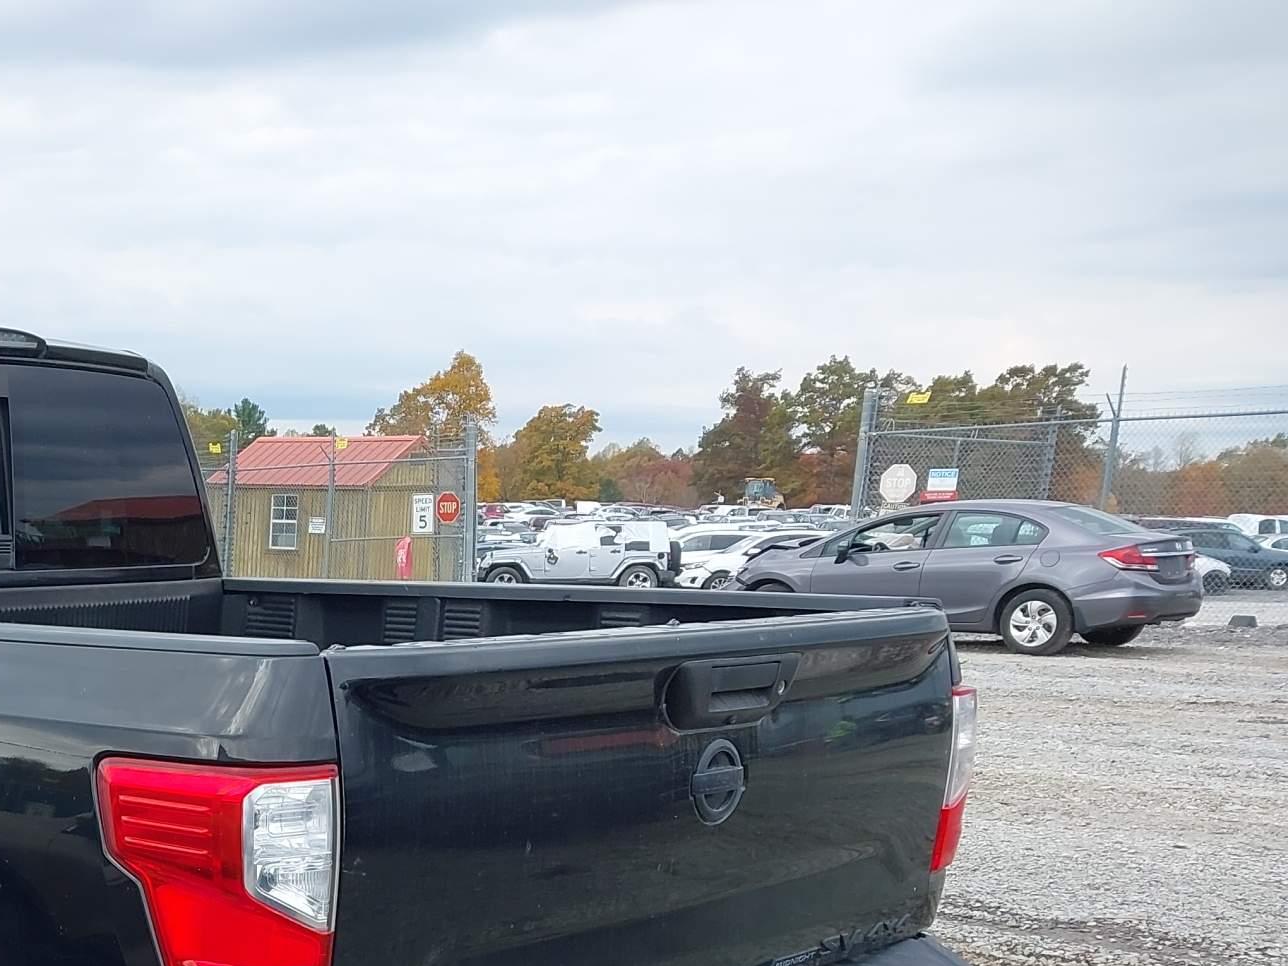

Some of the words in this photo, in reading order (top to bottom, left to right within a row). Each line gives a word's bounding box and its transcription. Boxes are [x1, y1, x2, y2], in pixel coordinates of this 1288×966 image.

[886, 478, 912, 488] STOP
[439, 502, 457, 513] STOP
[419, 515, 427, 529] 5
